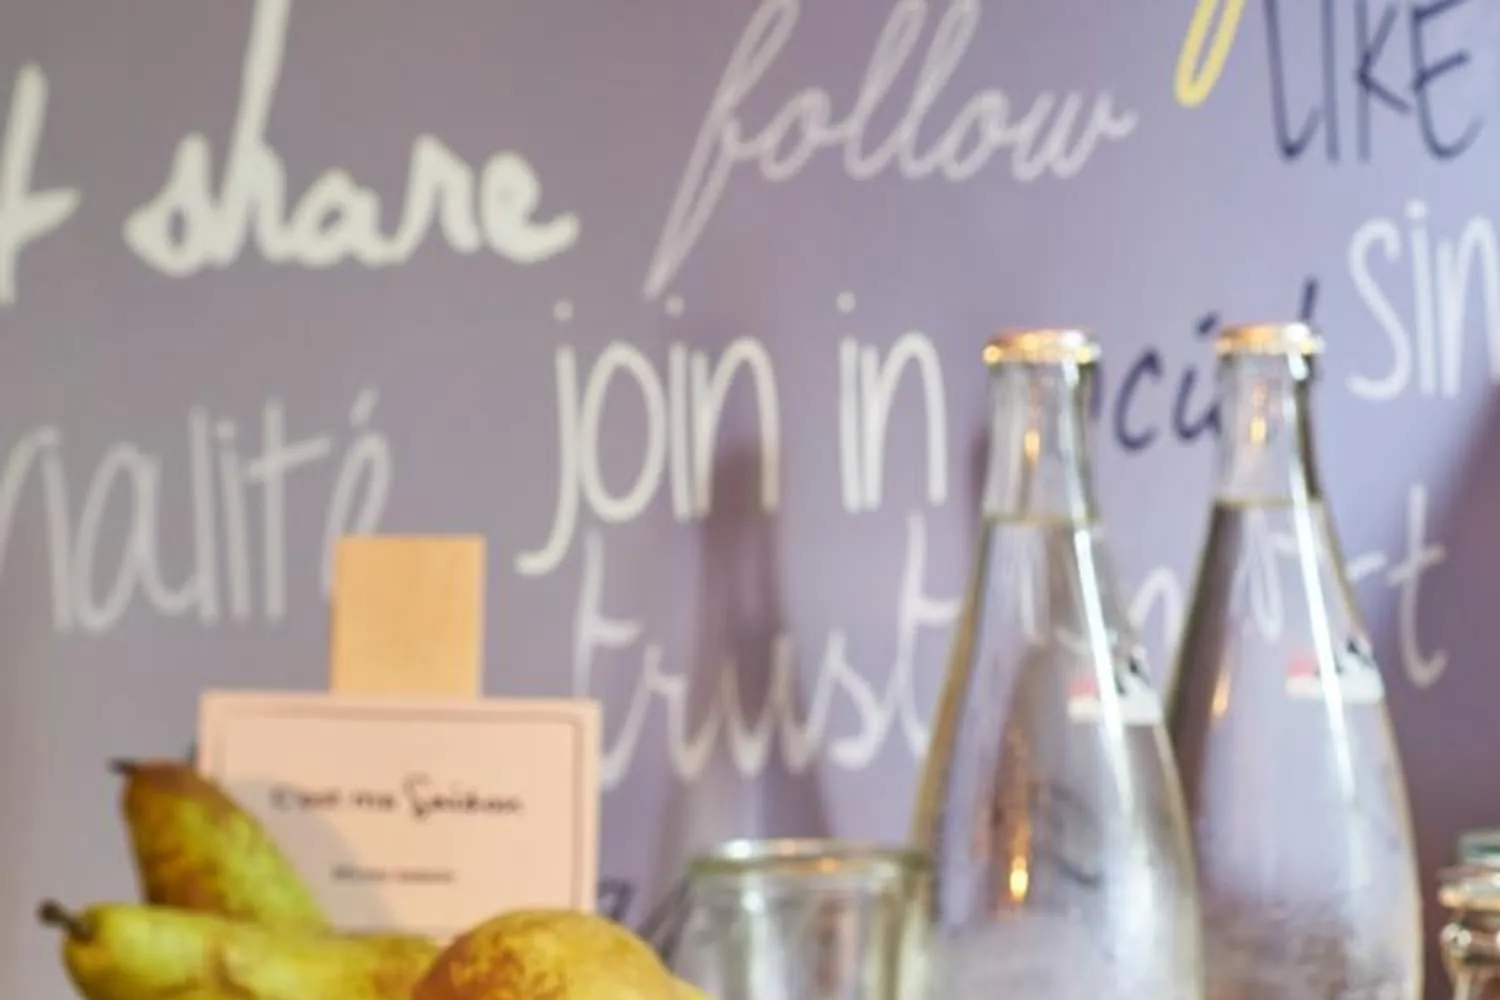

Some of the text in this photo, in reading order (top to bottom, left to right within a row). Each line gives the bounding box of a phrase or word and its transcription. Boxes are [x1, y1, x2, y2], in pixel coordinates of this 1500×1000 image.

[123, 0, 580, 277] share
[642, 0, 1138, 300] follow
[514, 295, 780, 576] join
[836, 292, 948, 512] in
